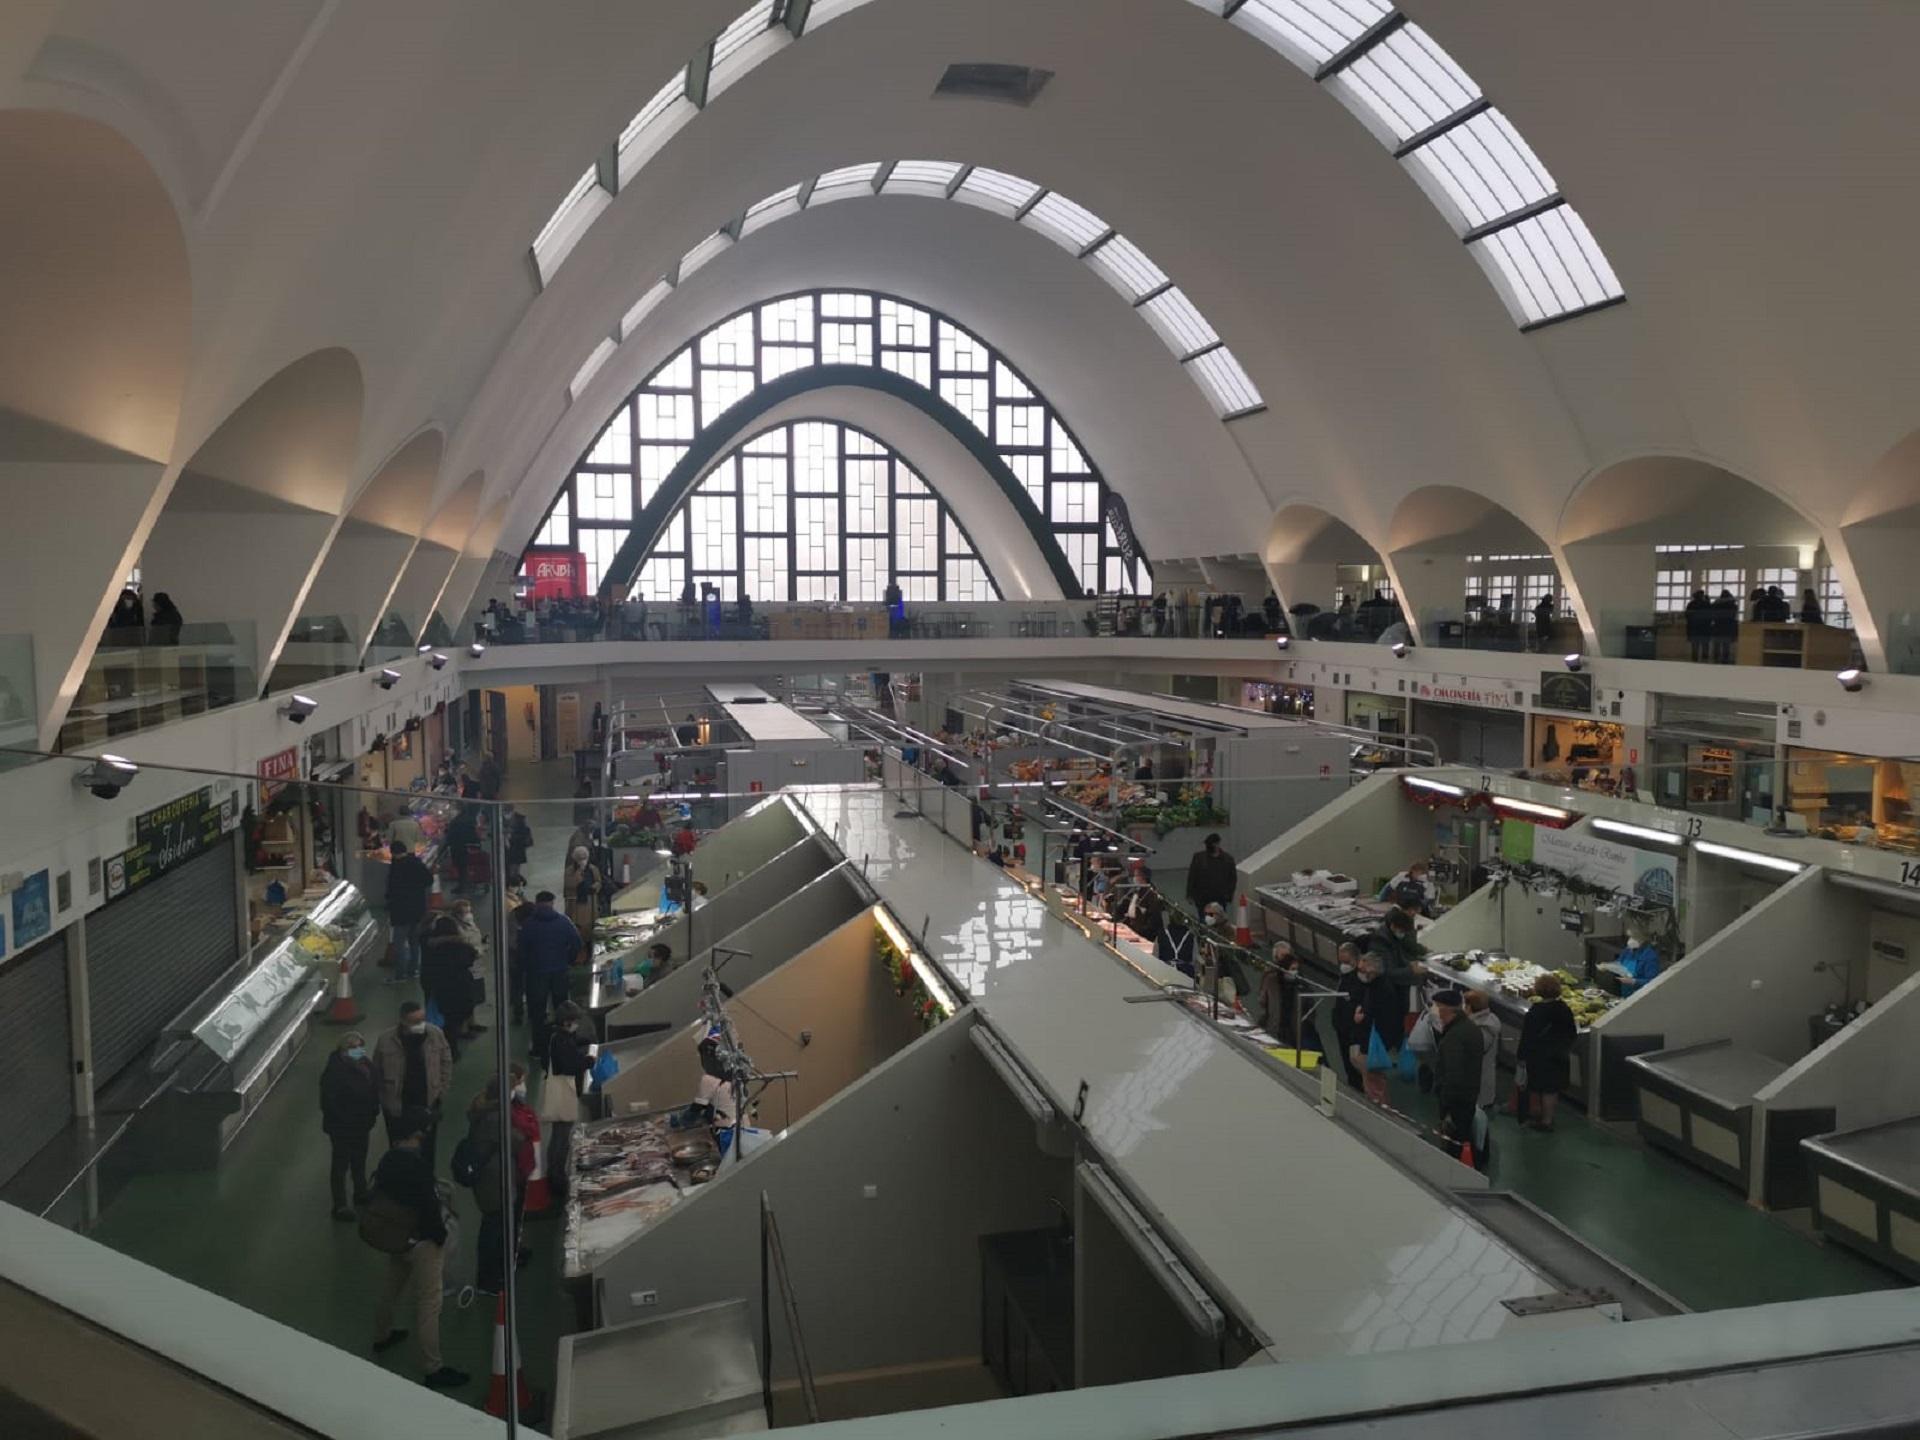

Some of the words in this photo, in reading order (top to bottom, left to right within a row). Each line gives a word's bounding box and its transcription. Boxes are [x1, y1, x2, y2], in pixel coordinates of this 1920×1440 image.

[263, 750, 294, 778] FINA
[1481, 775, 1492, 793] 12
[1687, 817, 1703, 837] 13
[1900, 860, 1920, 886] 14
